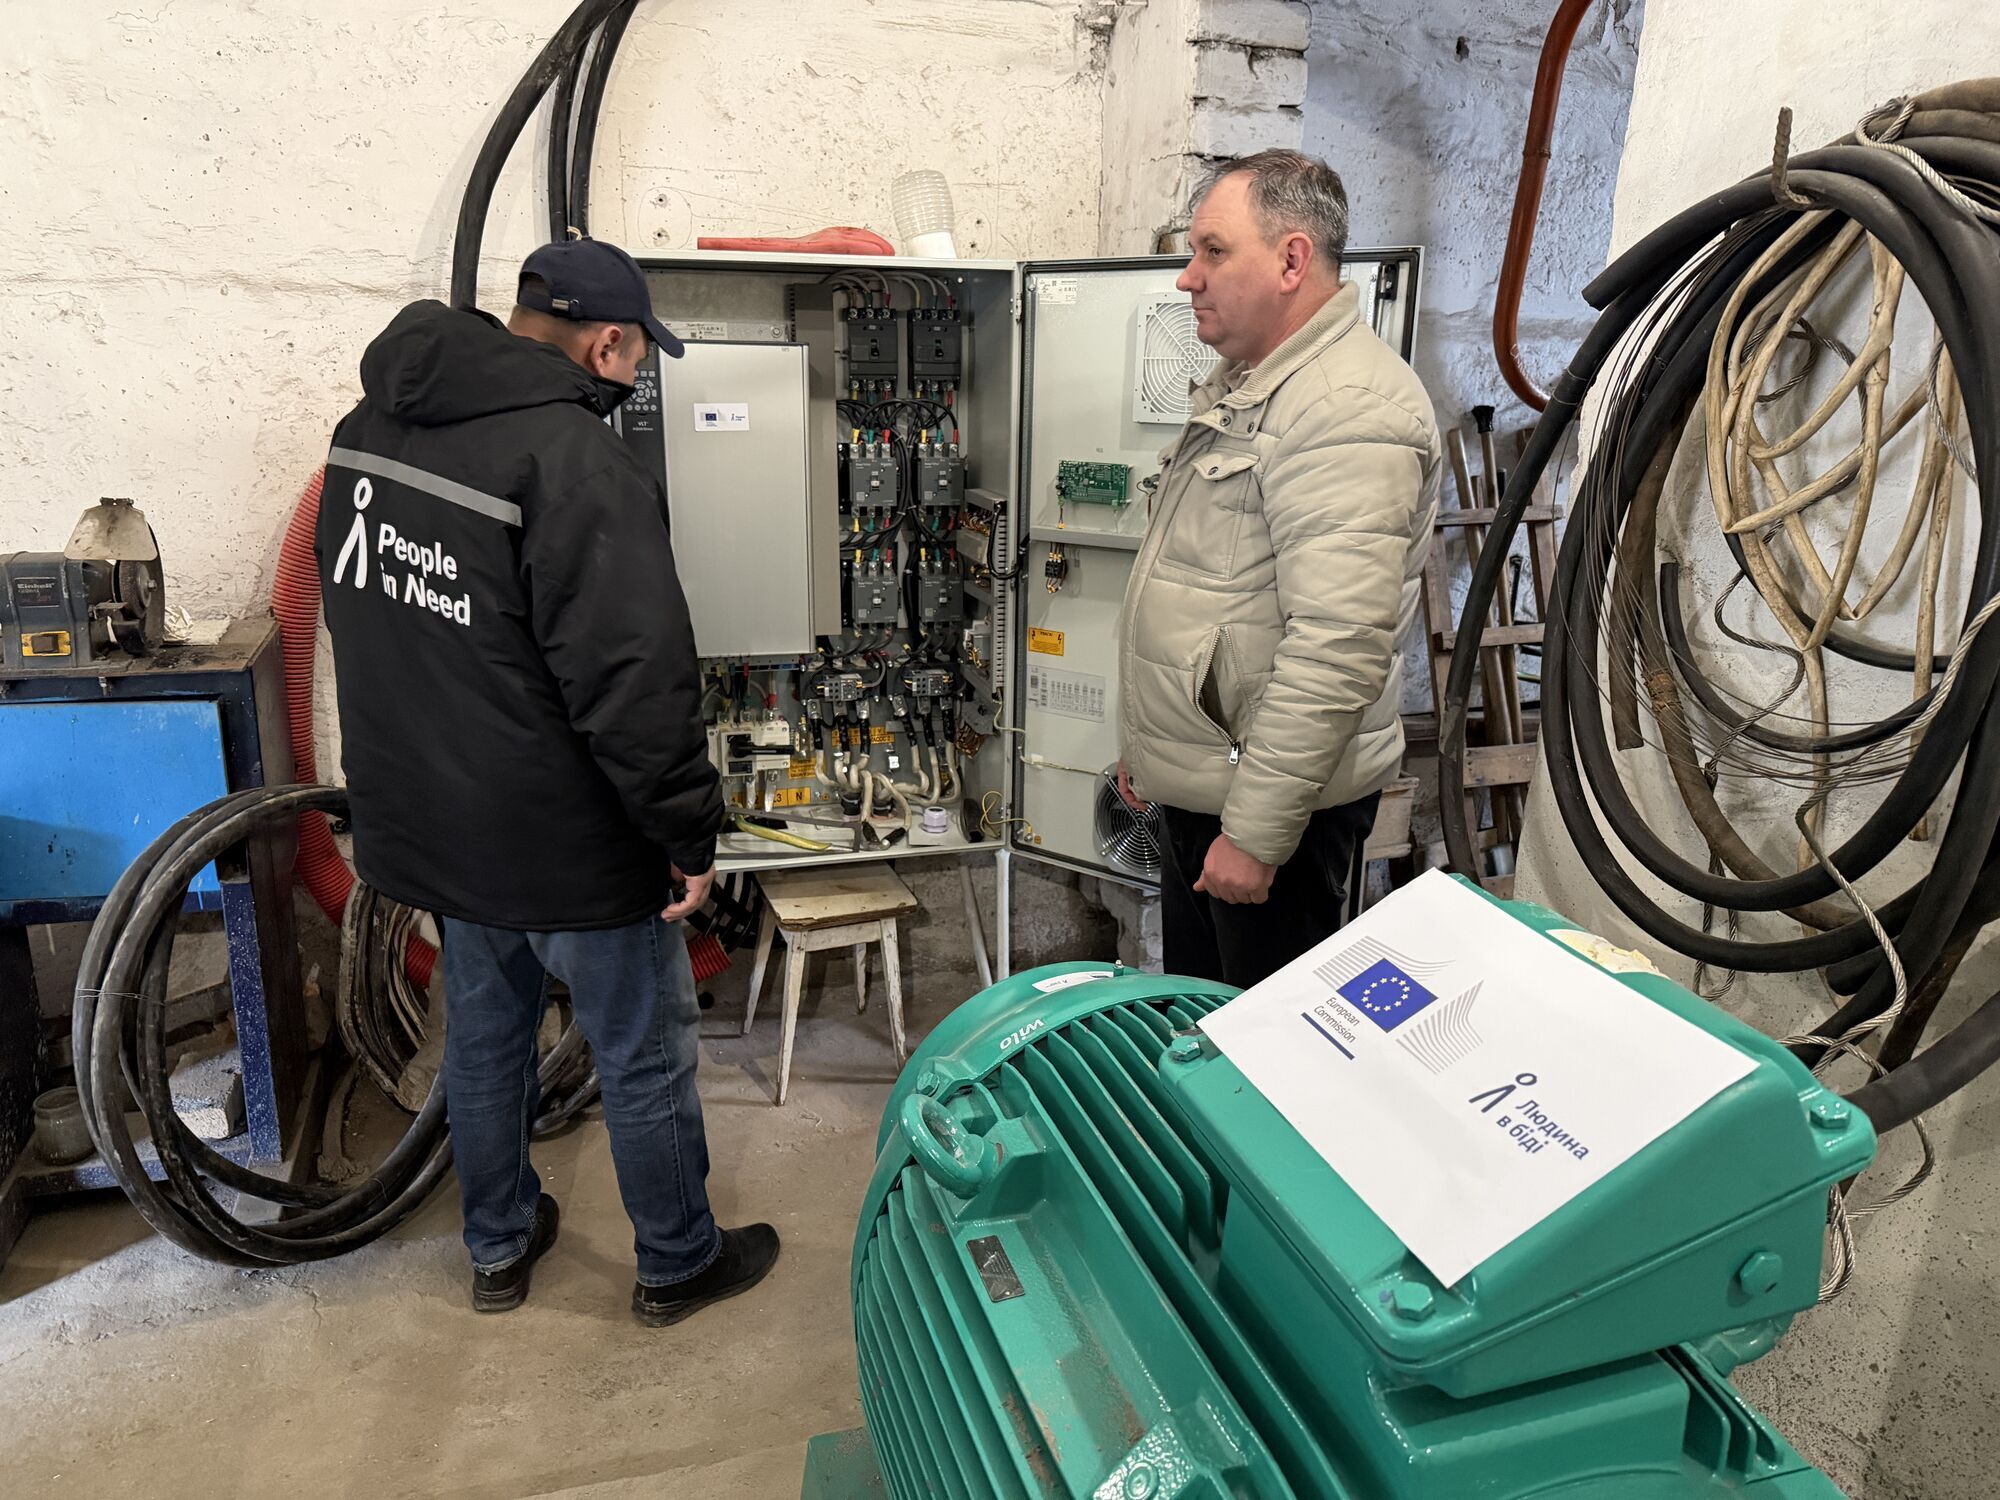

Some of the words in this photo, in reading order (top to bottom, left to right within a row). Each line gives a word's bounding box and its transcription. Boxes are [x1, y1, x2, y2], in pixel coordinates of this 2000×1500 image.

[377, 522, 458, 581] People
[380, 561, 398, 600] in
[403, 572, 471, 627] Need
[795, 791, 803, 801] N
[1313, 1005, 1357, 1044] Commission
[1326, 996, 1360, 1027] European
[1000, 1019, 1044, 1050] wilo
[1496, 1115, 1512, 1128] в
[1508, 1123, 1549, 1155] біді
[1515, 1099, 1589, 1161] Людина
